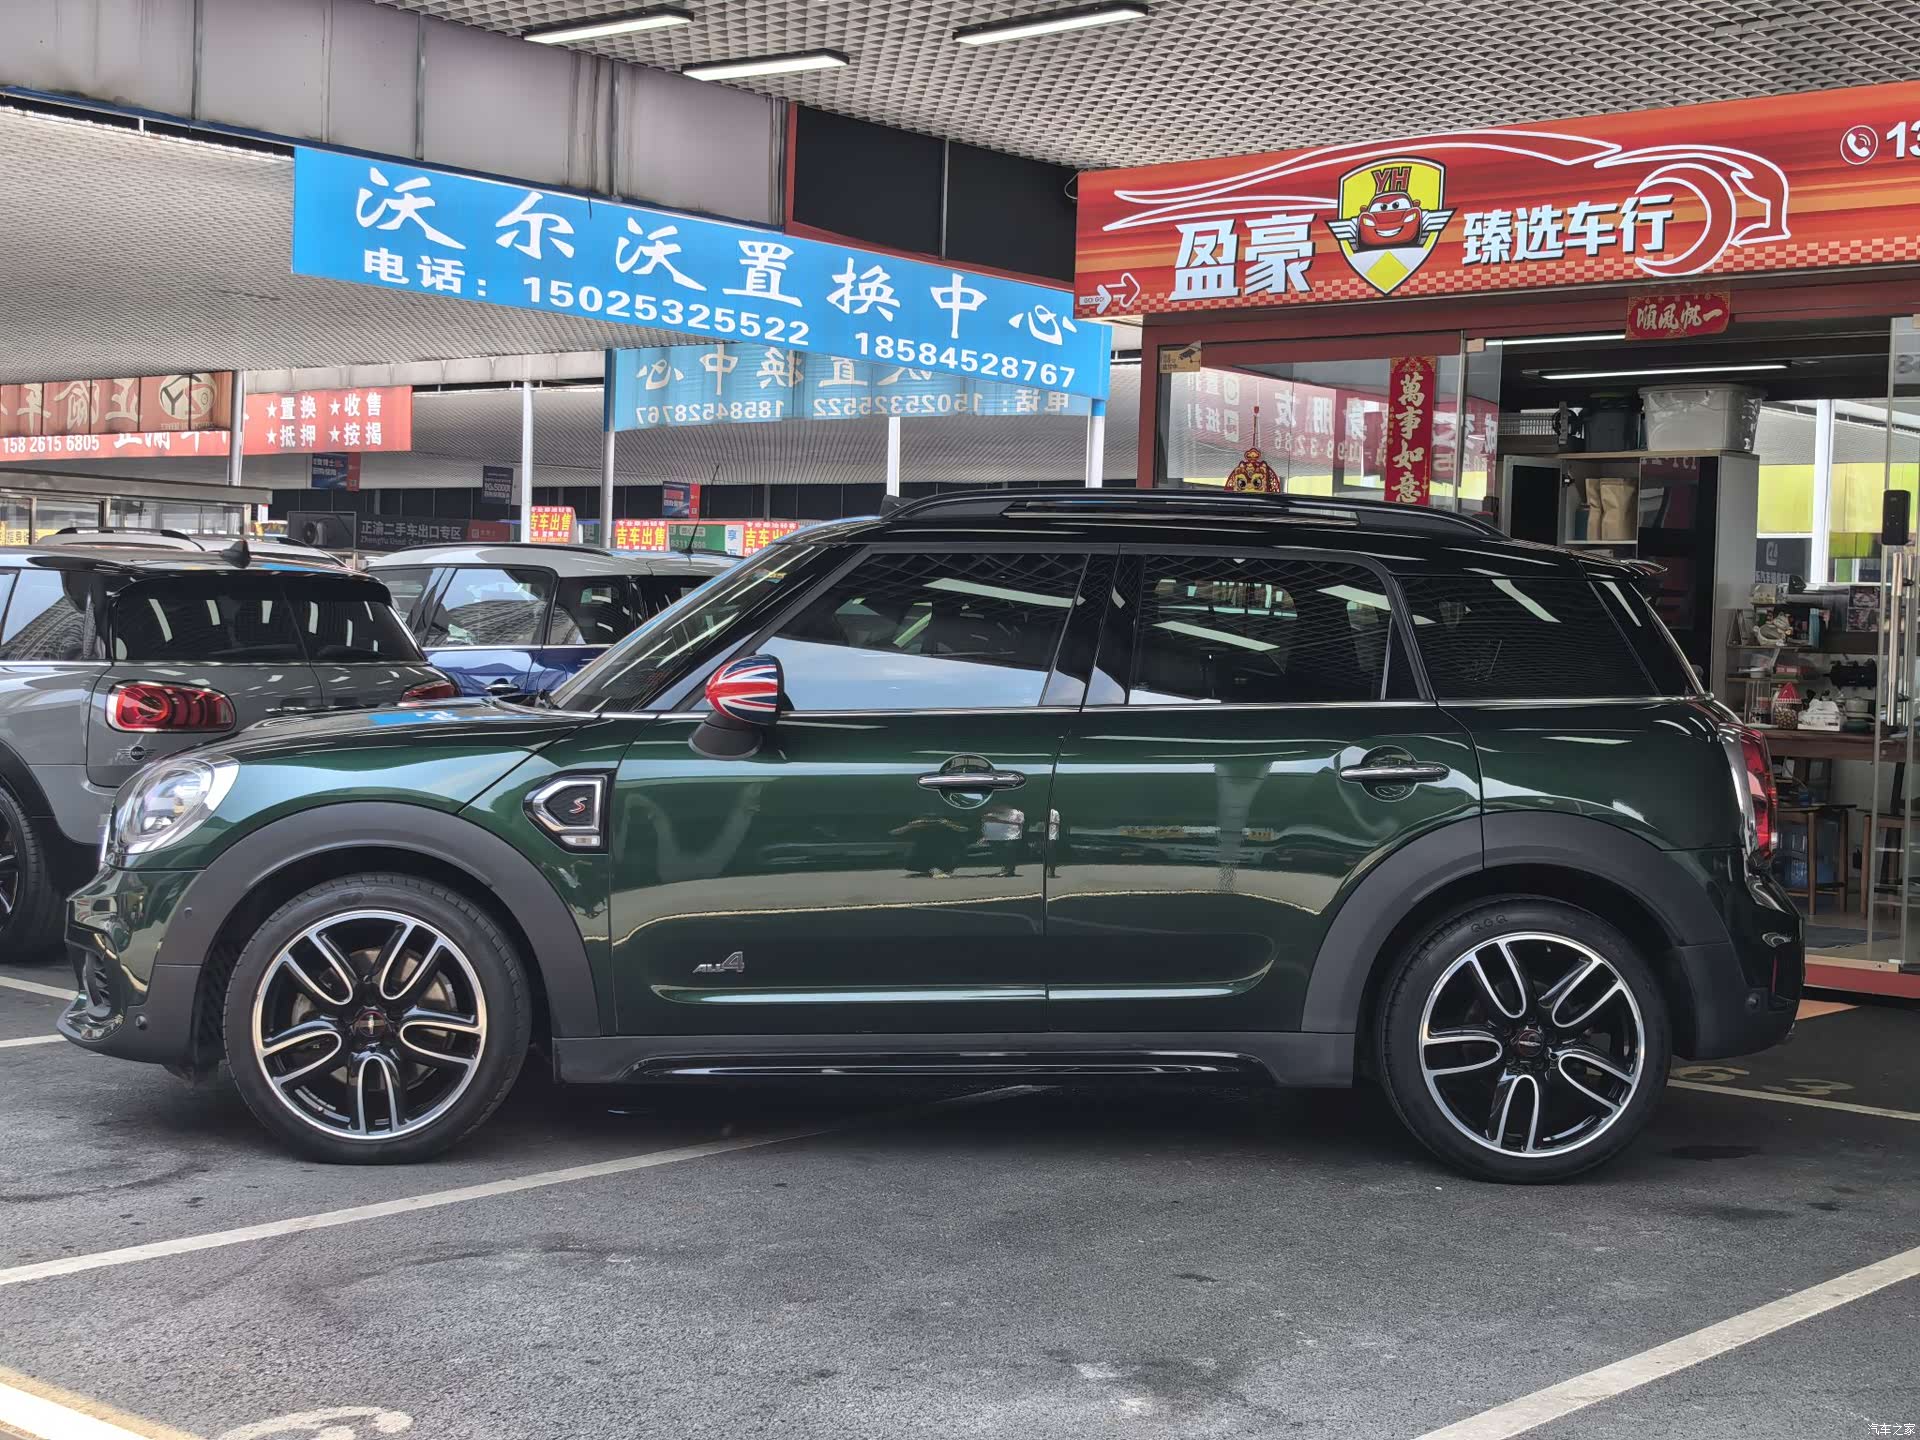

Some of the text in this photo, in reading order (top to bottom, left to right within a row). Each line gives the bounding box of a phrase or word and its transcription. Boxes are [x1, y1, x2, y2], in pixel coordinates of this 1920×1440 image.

[1372, 166, 1411, 193] YH
[356, 167, 1078, 345] 沃尔沃置换中心
[1169, 194, 1675, 300] 盈豪 臻选车行
[523, 277, 810, 346] 15025325522
[855, 332, 1076, 388] 18584528767
[280, 391, 382, 420] 置换 收售
[3, 437, 26, 453] 158
[29, 436, 62, 453] 2615
[66, 434, 100, 452] 6805
[280, 422, 382, 448] 抵押 按揭
[361, 520, 463, 541] 正渝二手车出口专区
[617, 526, 665, 546] 吉车出售
[568, 796, 588, 814] S
